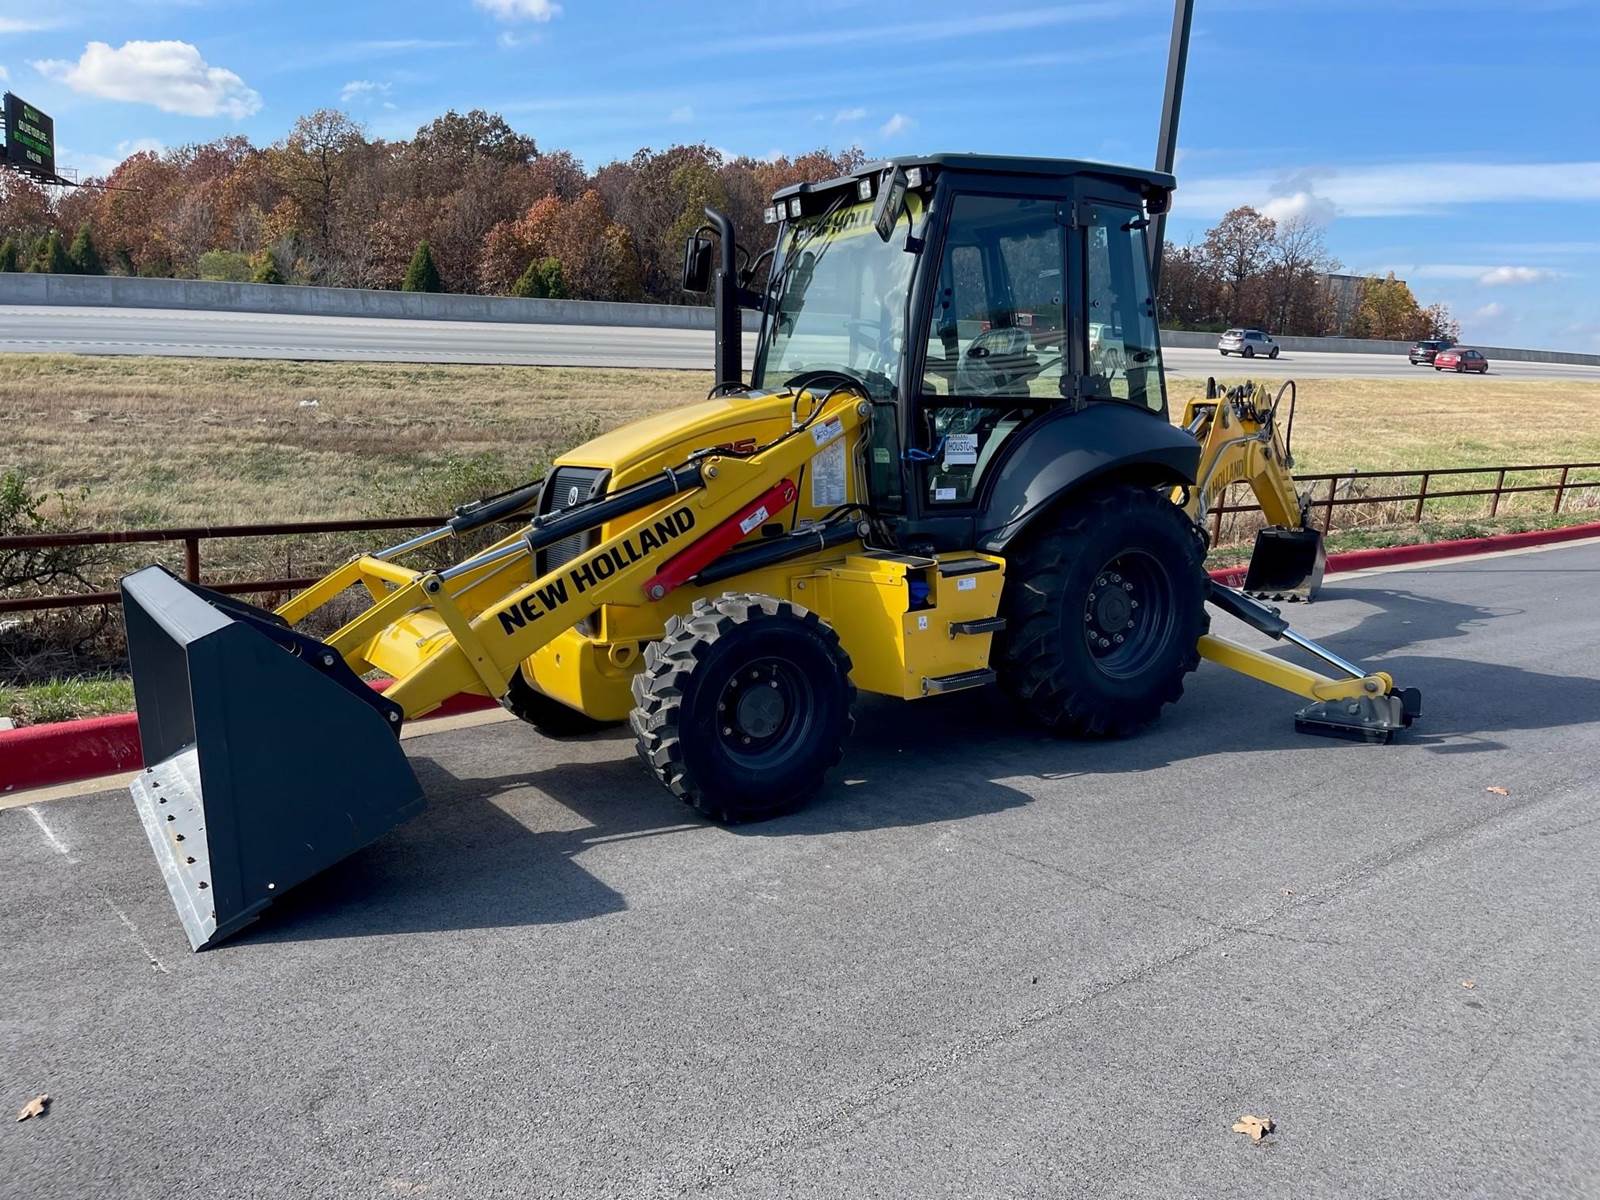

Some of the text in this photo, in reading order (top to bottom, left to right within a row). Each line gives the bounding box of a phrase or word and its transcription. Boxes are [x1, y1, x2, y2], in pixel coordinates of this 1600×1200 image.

[1212, 460, 1244, 499] HOLLAND
[498, 507, 695, 634] NEW HOLLAND
